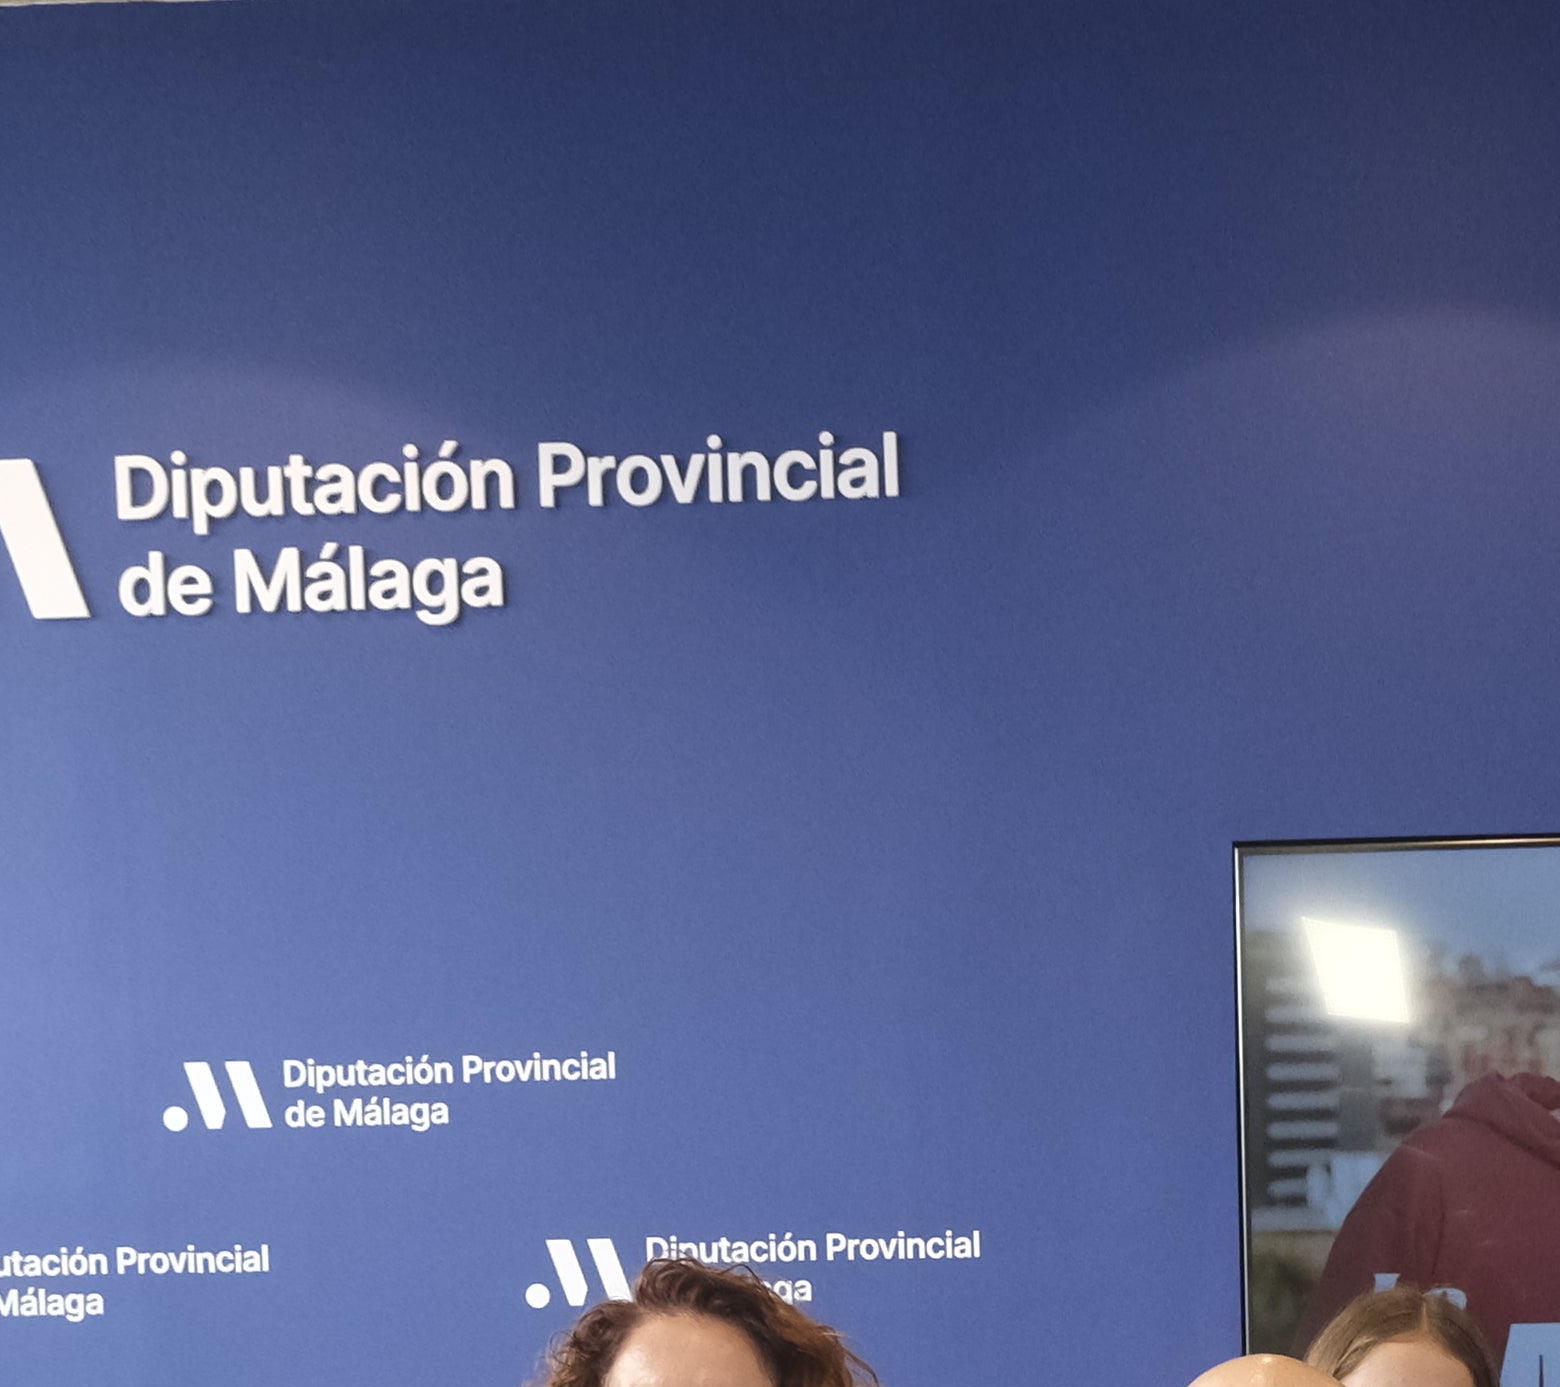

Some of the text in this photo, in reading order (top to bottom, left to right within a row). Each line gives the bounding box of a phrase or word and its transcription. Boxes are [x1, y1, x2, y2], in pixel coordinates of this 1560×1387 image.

[114, 431, 901, 535] Diputación Provincial
[119, 541, 504, 627] de Málaga
[283, 1051, 616, 1093] Diputación Provincial
[285, 1095, 449, 1132] de Málaga
[116, 1244, 270, 1275] Provincial
[826, 1229, 981, 1261] Provincial
